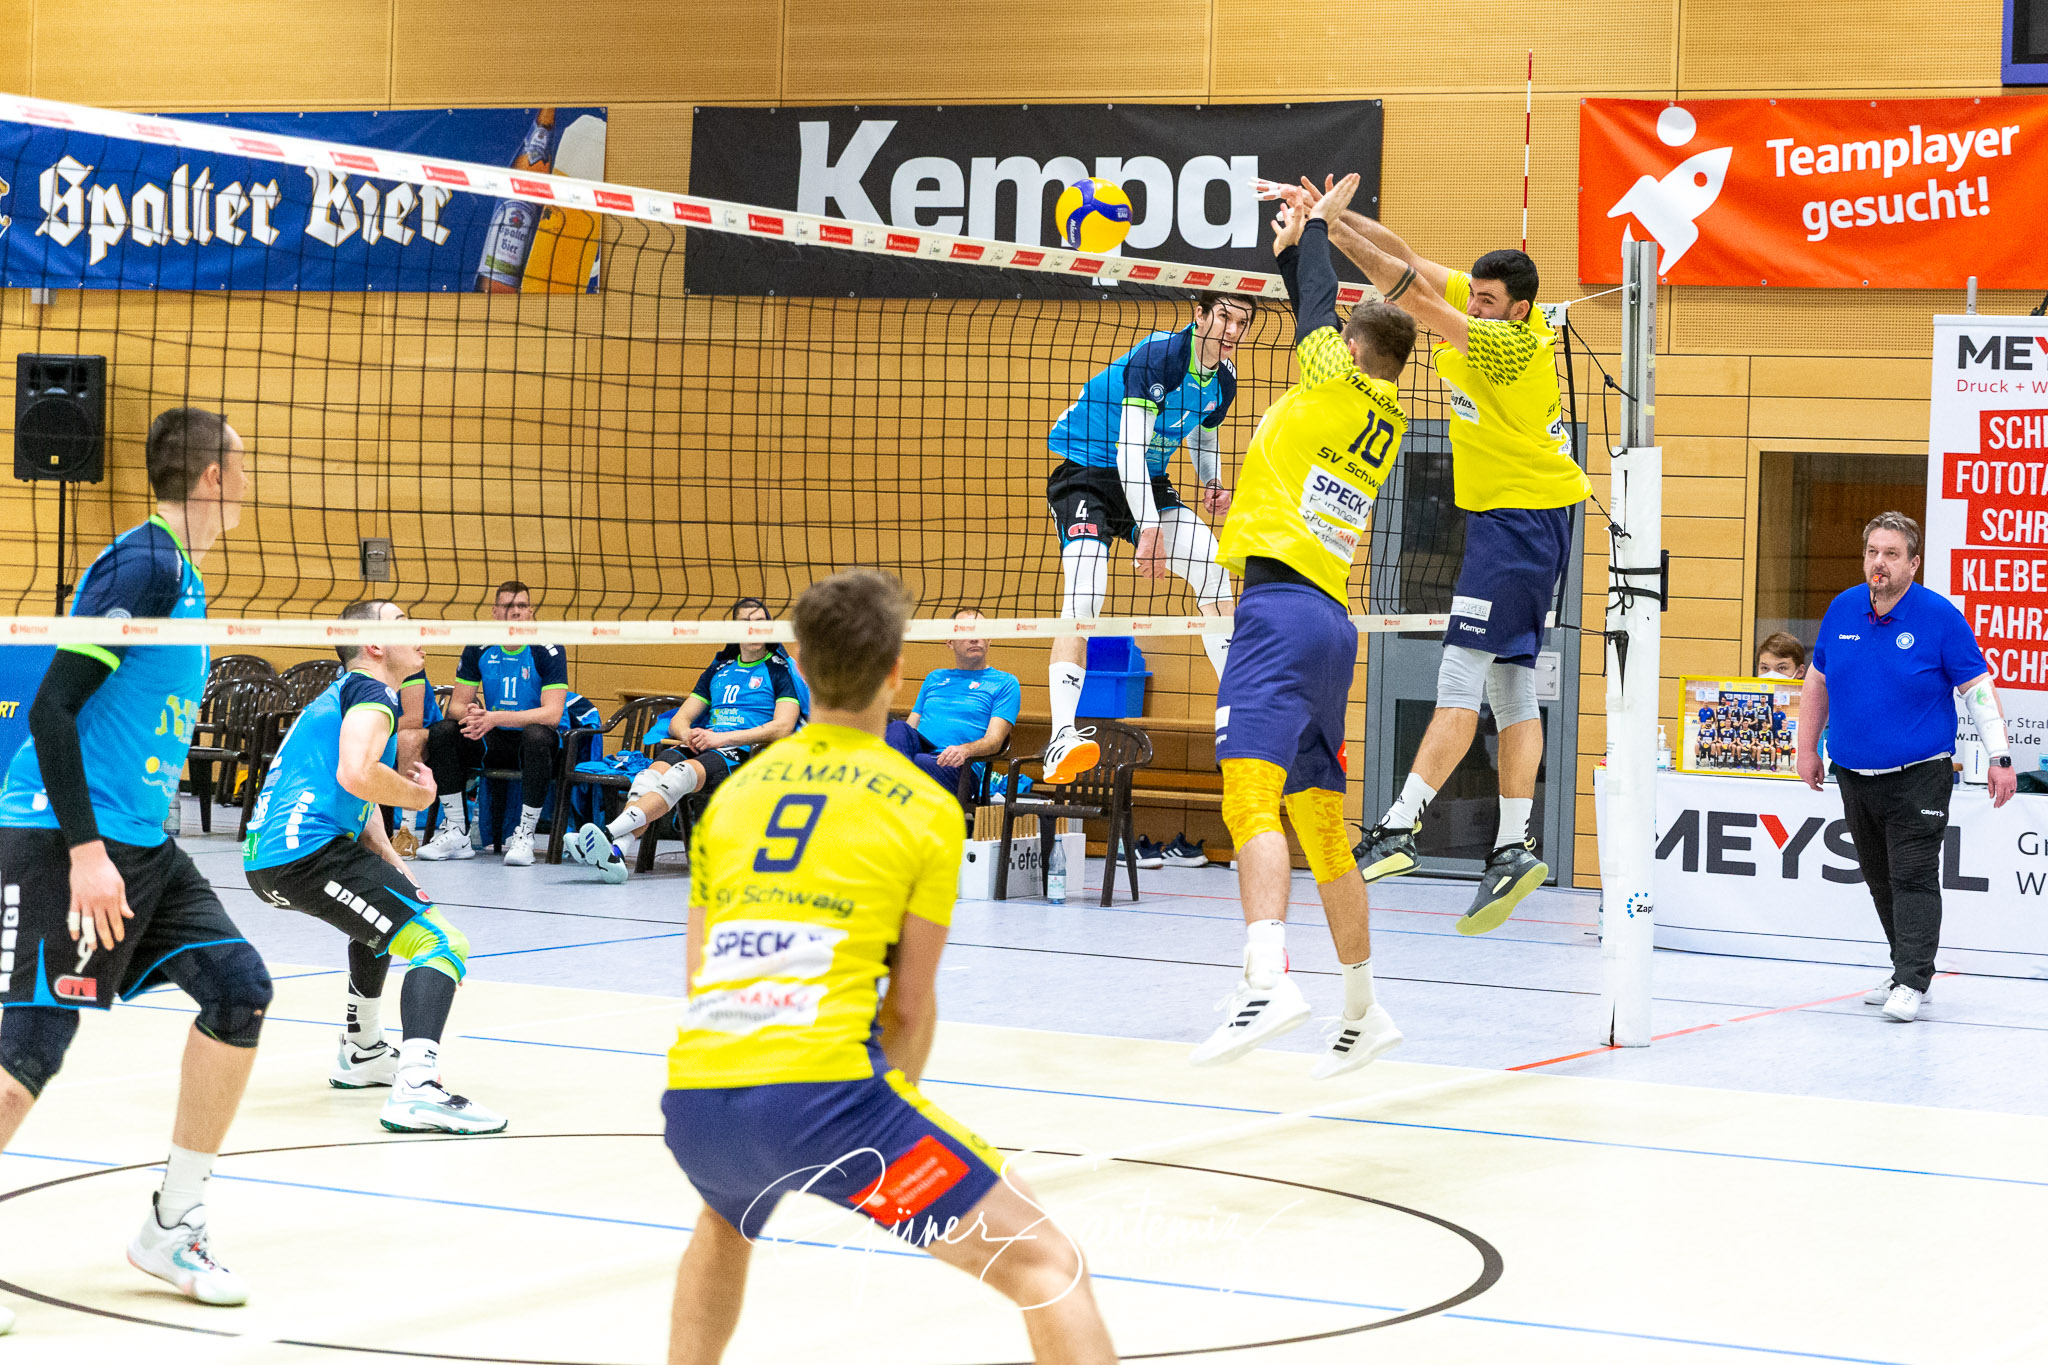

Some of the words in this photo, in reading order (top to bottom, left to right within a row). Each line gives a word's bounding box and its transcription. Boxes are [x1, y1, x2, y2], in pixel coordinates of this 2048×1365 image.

[1766, 124, 2020, 179] Teamplayer
[36, 155, 283, 266] Spalter
[305, 165, 453, 247] Bier
[796, 119, 1260, 286] Kempa
[1802, 176, 1991, 242] gesucht!
[1957, 379, 2009, 393] Druck
[1317, 446, 1343, 464] SV
[1347, 409, 1395, 469] 10
[1075, 499, 1089, 521] 4
[1312, 474, 1367, 515] SPECK
[1979, 508, 2048, 544] SCHR
[1962, 558, 2048, 593] KLEBE
[1460, 621, 1487, 635] Kempa
[502, 676, 518, 699] 11
[722, 684, 741, 705] 10
[2017, 717, 2048, 729] Stra
[753, 794, 828, 873] 9
[1655, 808, 1990, 893] MEYSL
[740, 885, 856, 919] Schwaig
[1636, 904, 1654, 914] Zap
[712, 930, 798, 958] SPECK
